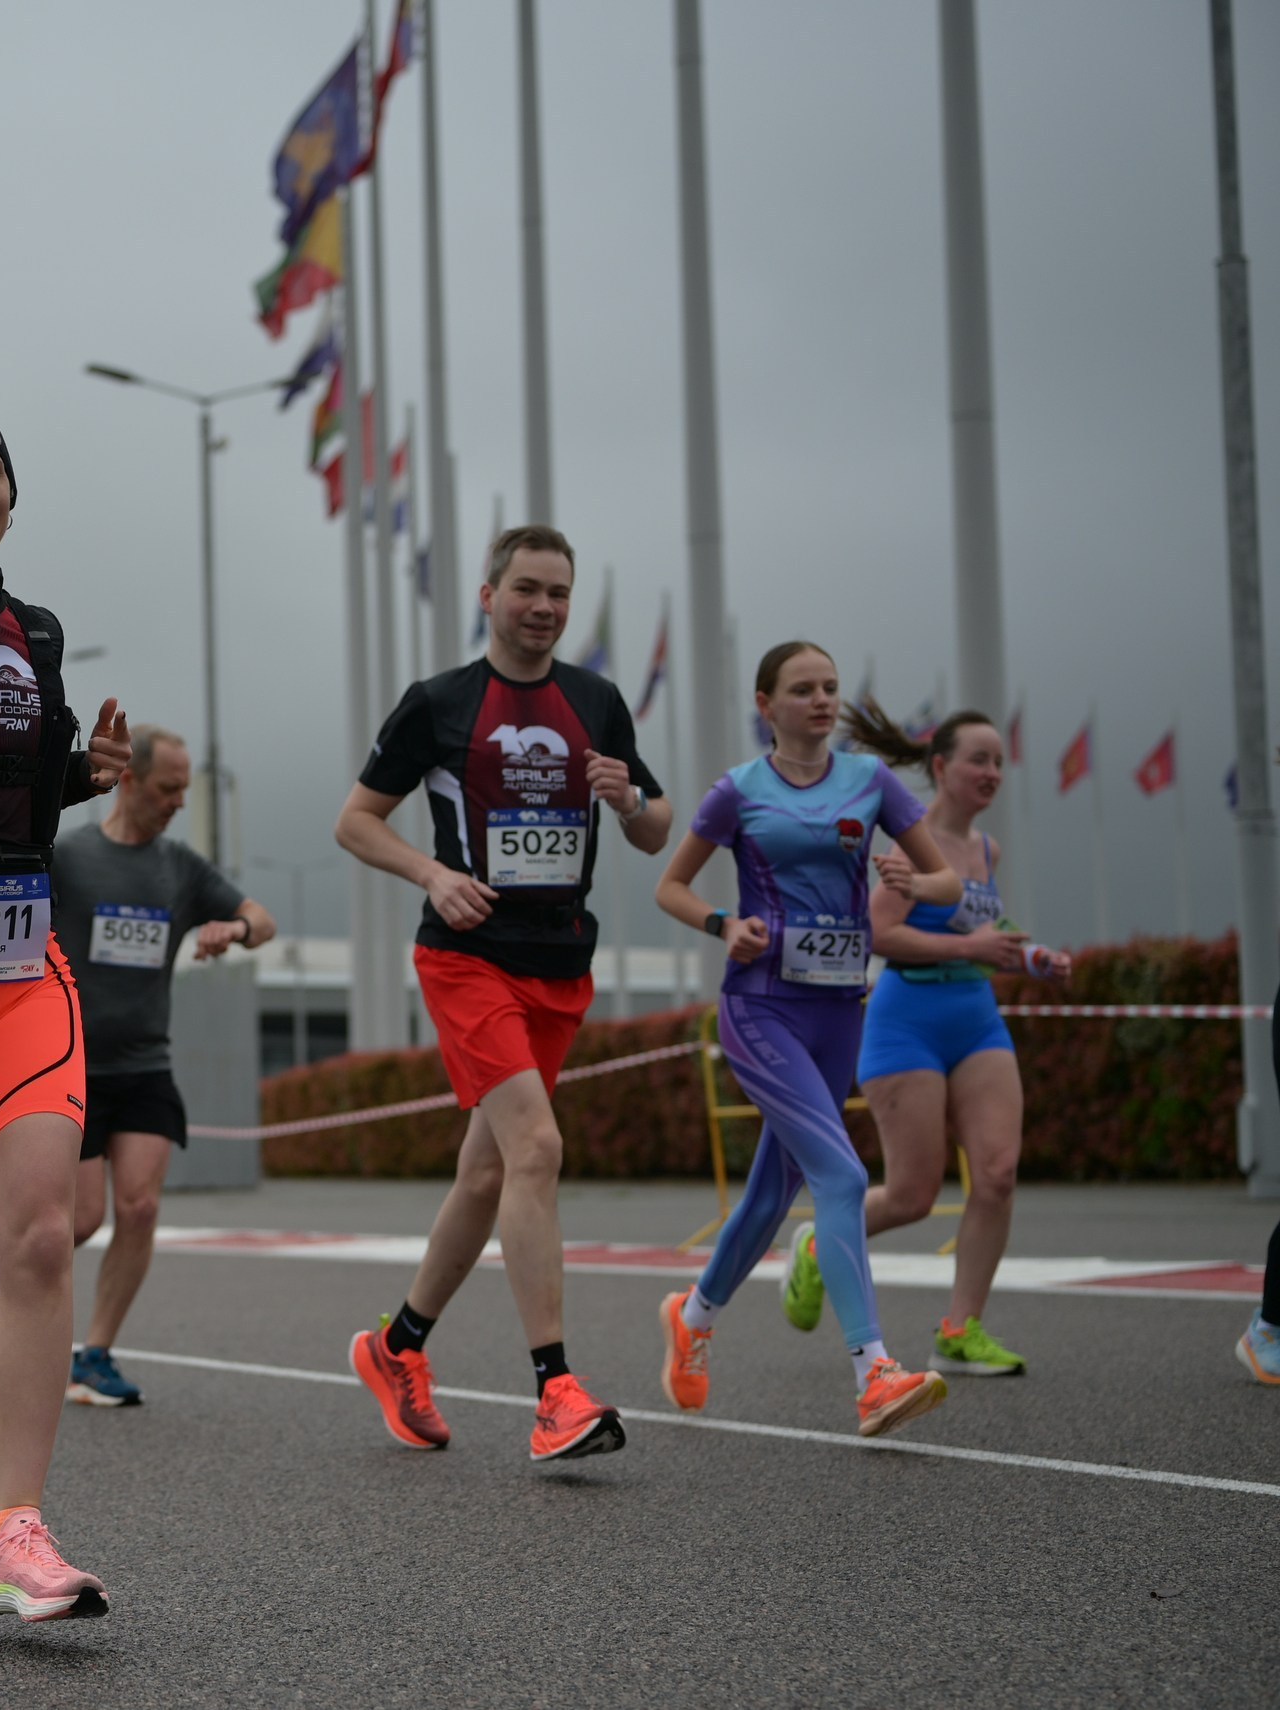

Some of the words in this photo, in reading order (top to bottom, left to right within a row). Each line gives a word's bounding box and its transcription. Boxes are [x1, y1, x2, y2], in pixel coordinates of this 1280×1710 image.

[486, 723, 570, 758] 10
[502, 768, 566, 782] SIRIUS
[501, 829, 578, 856] 5023
[104, 919, 162, 945] 5052
[796, 931, 862, 958] 4275
